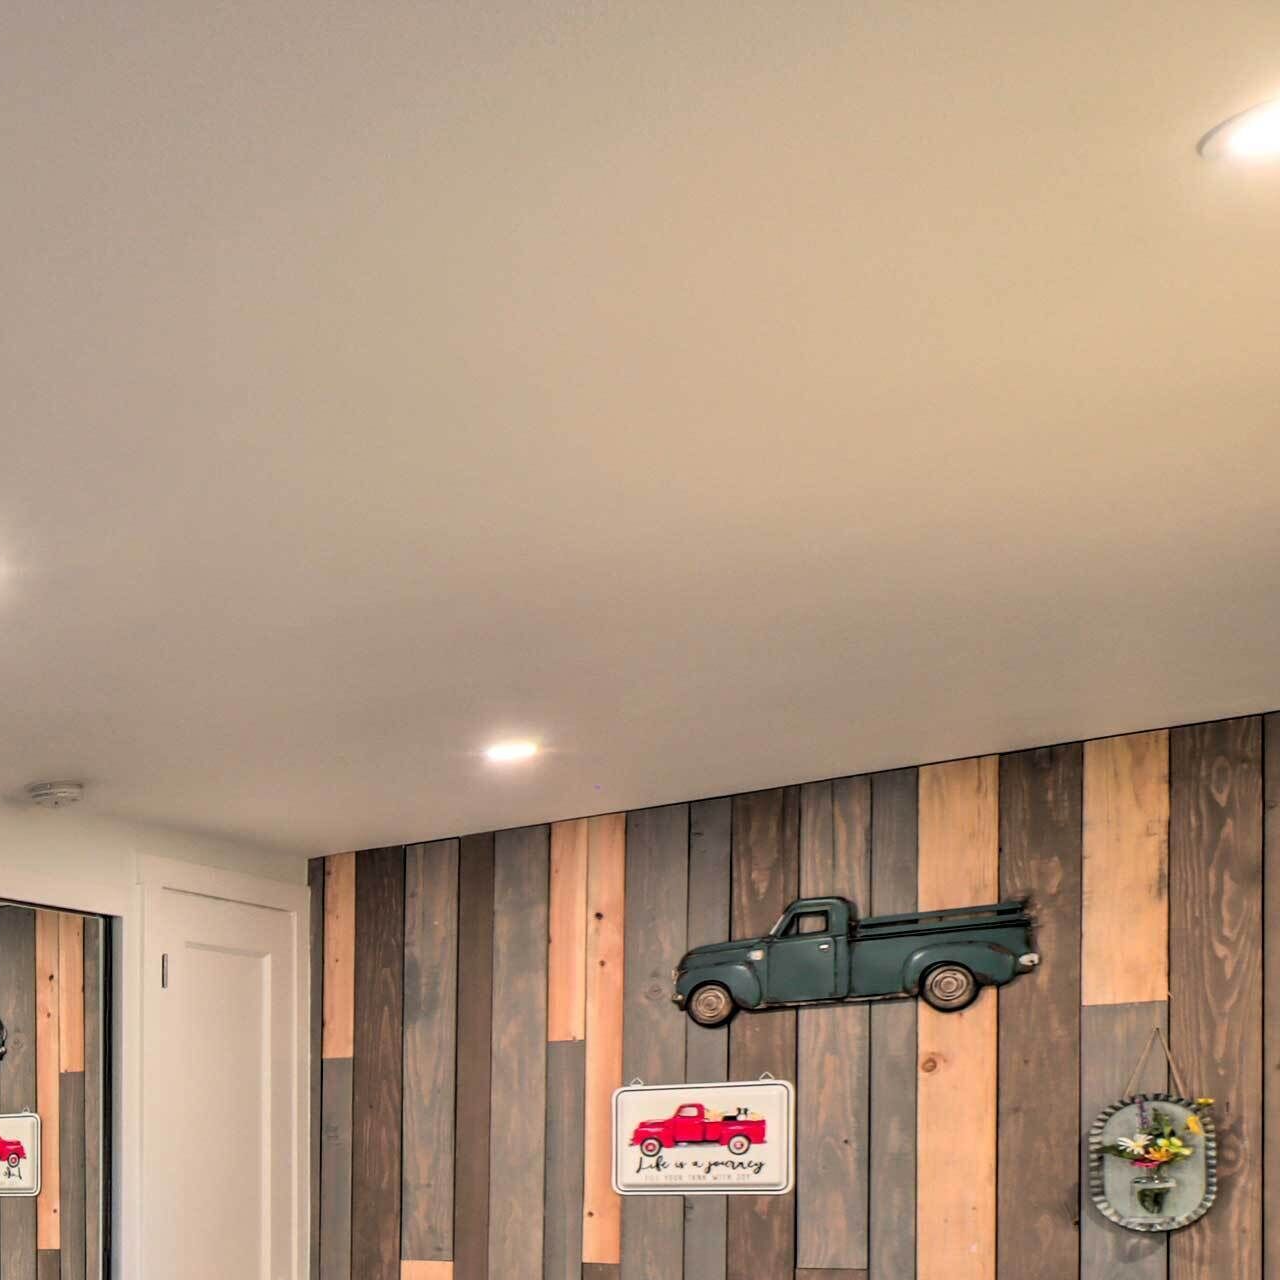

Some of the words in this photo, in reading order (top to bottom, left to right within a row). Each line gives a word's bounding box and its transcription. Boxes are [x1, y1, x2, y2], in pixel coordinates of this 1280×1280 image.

[636, 1155, 670, 1174] Life
[674, 1160, 687, 1169] is
[692, 1160, 704, 1168] a
[704, 1159, 766, 1174] journey
